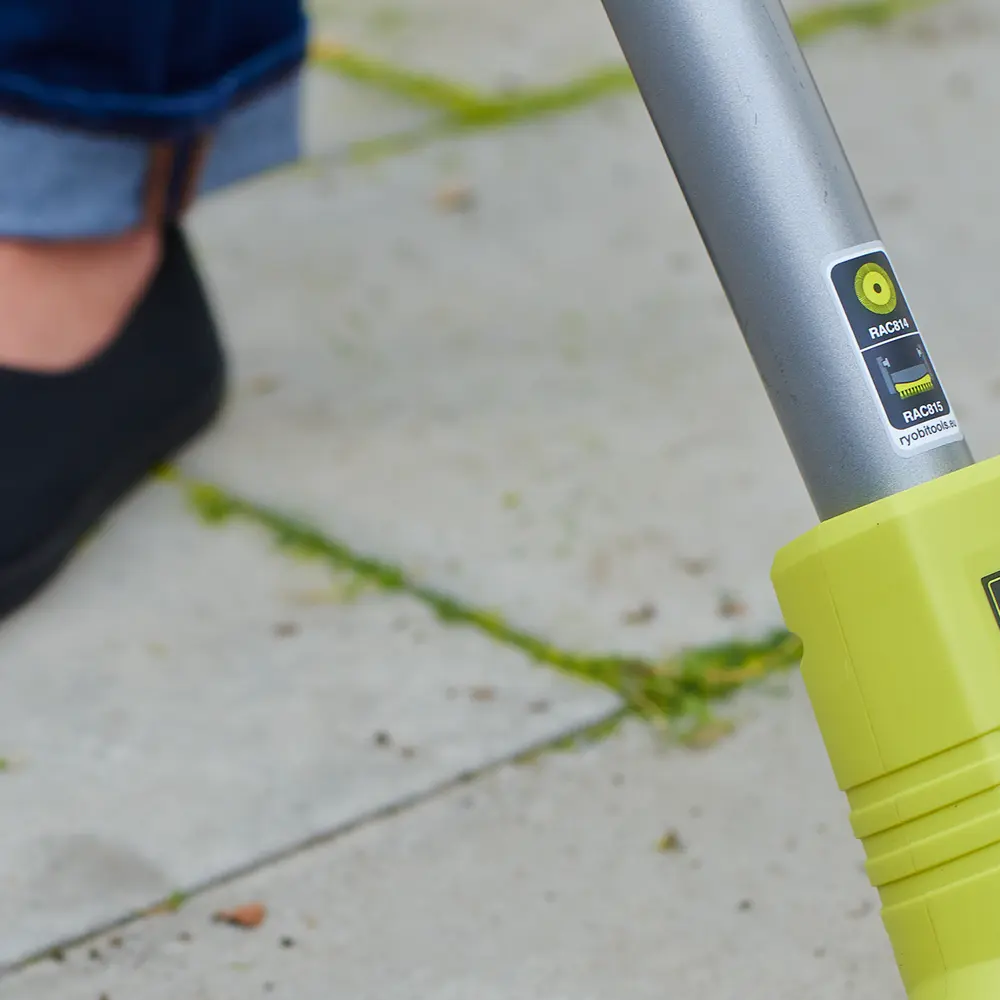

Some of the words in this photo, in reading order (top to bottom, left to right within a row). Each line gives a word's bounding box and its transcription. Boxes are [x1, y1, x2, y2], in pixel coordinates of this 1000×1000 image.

[868, 318, 909, 340] RAC814
[902, 401, 944, 423] RAC815
[899, 418, 957, 446] ryobitools.eu
